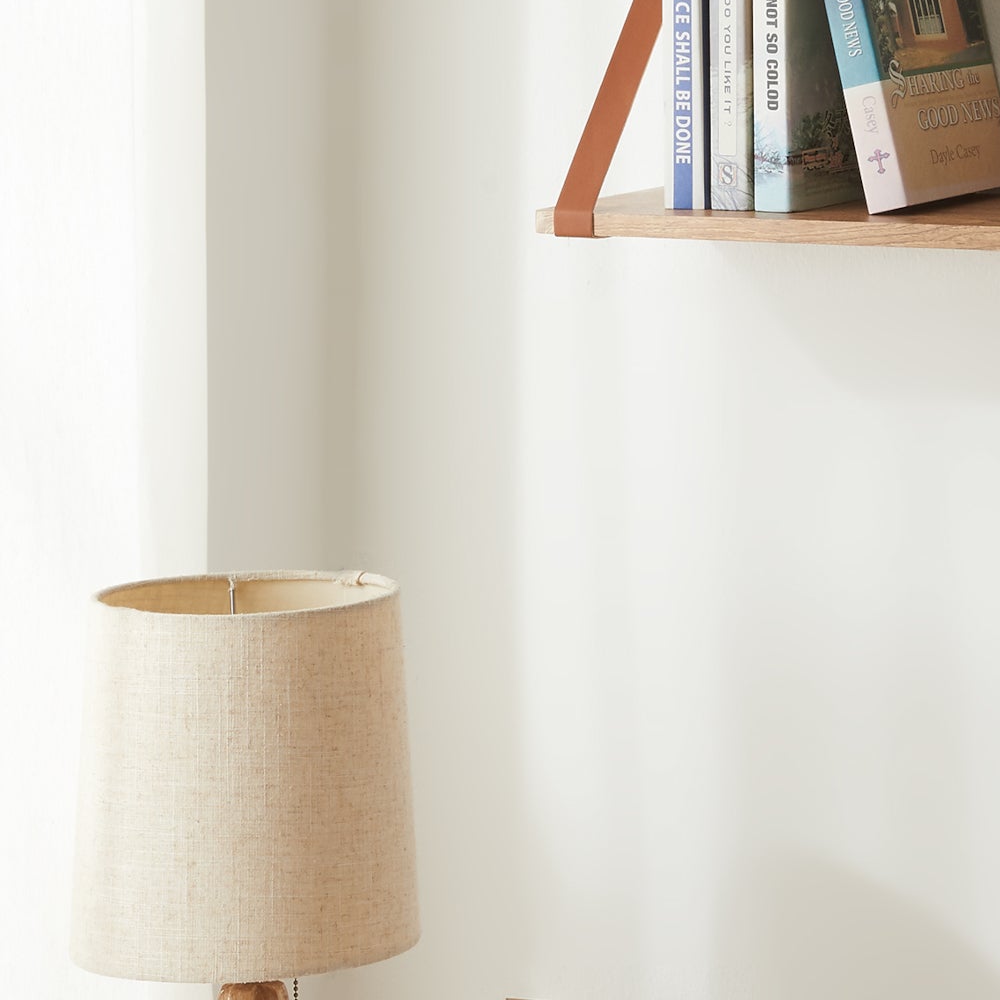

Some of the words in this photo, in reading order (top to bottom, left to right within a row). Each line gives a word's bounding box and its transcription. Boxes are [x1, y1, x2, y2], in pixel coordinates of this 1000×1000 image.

[766, 33, 778, 54] SO
[843, 21, 863, 57] NEWS
[675, 31, 691, 85] SHALL
[675, 90, 691, 111] BE
[766, 59, 779, 111] COLOD
[888, 60, 965, 109] SHARING
[966, 70, 980, 86] the
[723, 100, 731, 114] IT
[863, 95, 879, 133] Casey
[917, 104, 959, 131] GOOD
[675, 115, 692, 164] DONE
[930, 145, 955, 166] Dayle
[956, 144, 980, 160] Casey
